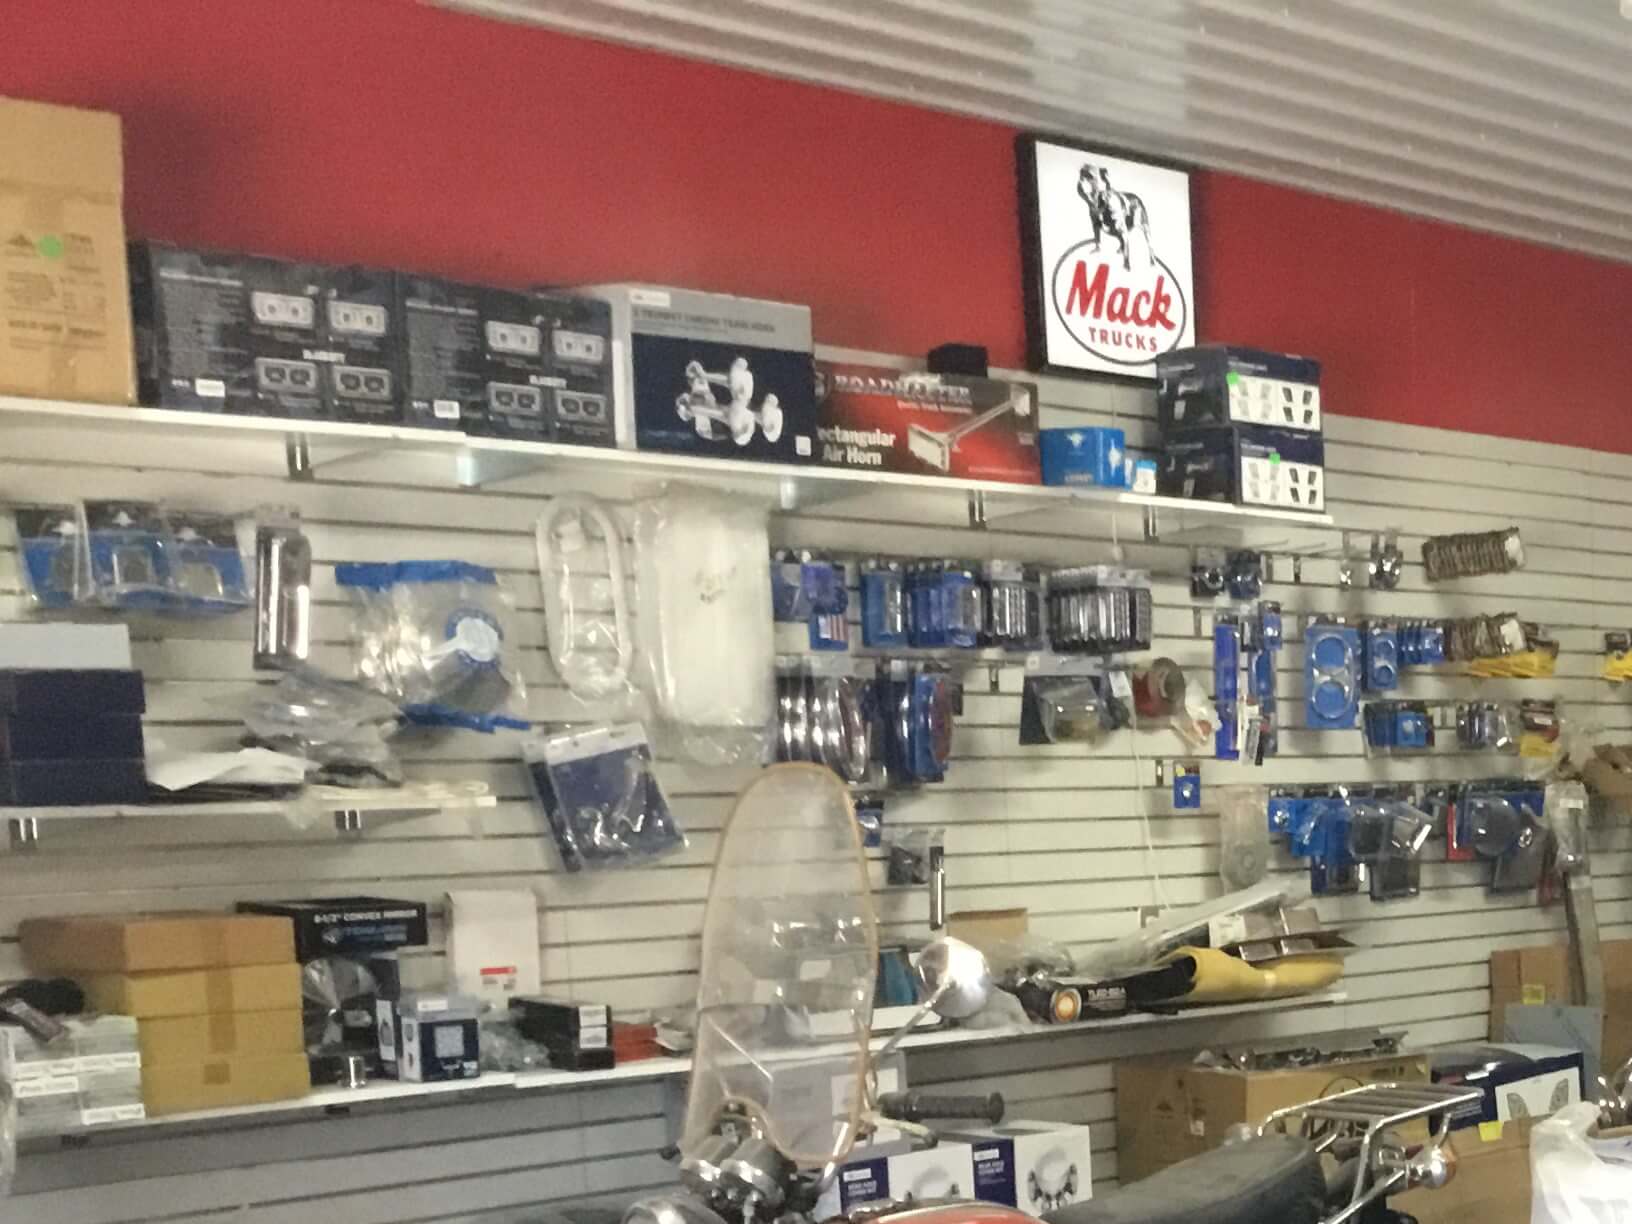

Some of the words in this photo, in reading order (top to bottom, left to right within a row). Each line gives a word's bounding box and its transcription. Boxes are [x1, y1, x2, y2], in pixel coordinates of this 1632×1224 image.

[1065, 260, 1177, 332] Mack
[1088, 326, 1159, 353] TRUCKS
[816, 425, 896, 449] ectangular
[823, 444, 845, 462] Air
[846, 446, 882, 465] Horn
